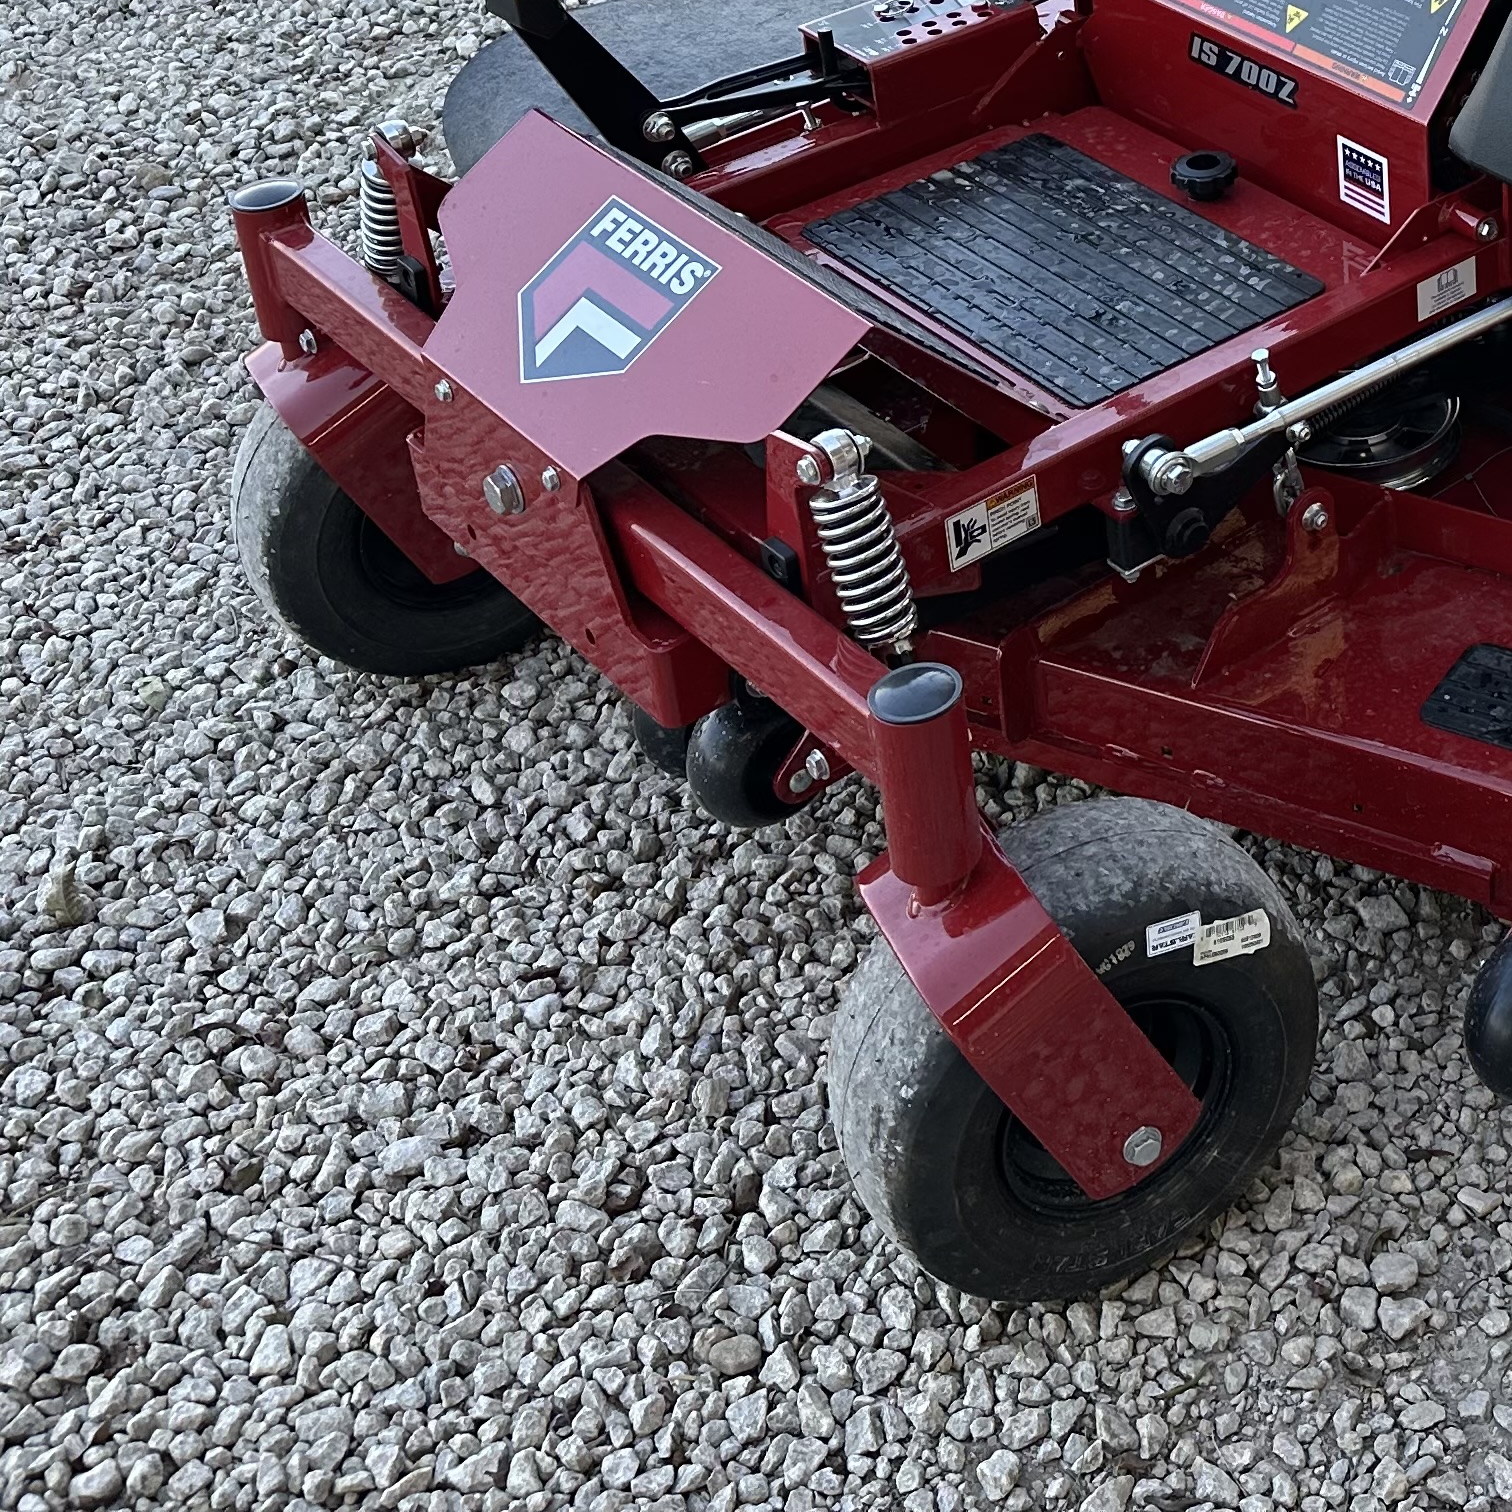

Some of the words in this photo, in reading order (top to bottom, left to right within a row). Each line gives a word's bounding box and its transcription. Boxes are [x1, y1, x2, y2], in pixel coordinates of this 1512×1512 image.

[1191, 36, 1219, 66] IS
[1224, 51, 1296, 104] 700Z
[1365, 177, 1381, 191] USA
[590, 207, 706, 295] FERRIS
[1151, 930, 1195, 953] ARLSTAR
